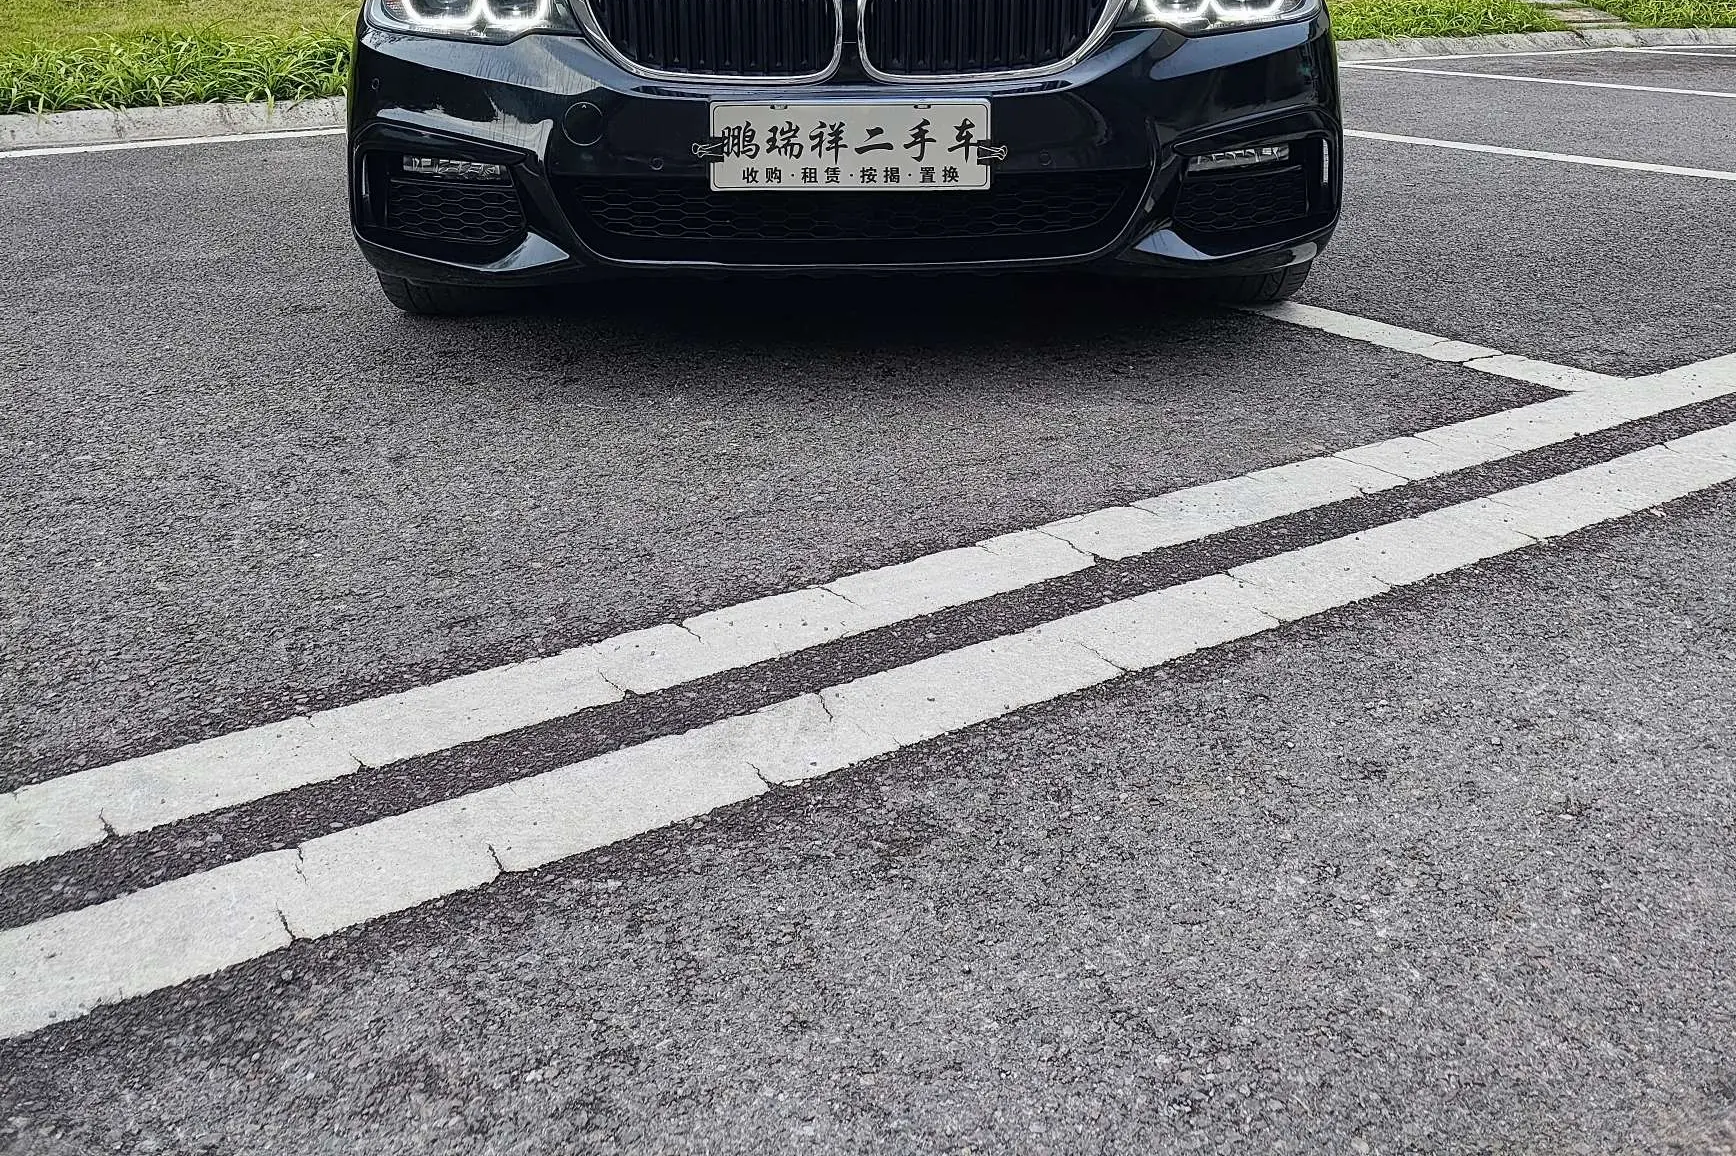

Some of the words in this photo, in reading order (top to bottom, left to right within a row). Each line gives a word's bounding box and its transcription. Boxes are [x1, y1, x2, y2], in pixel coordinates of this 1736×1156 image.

[721, 118, 979, 164] 鹏瑞祥二手车
